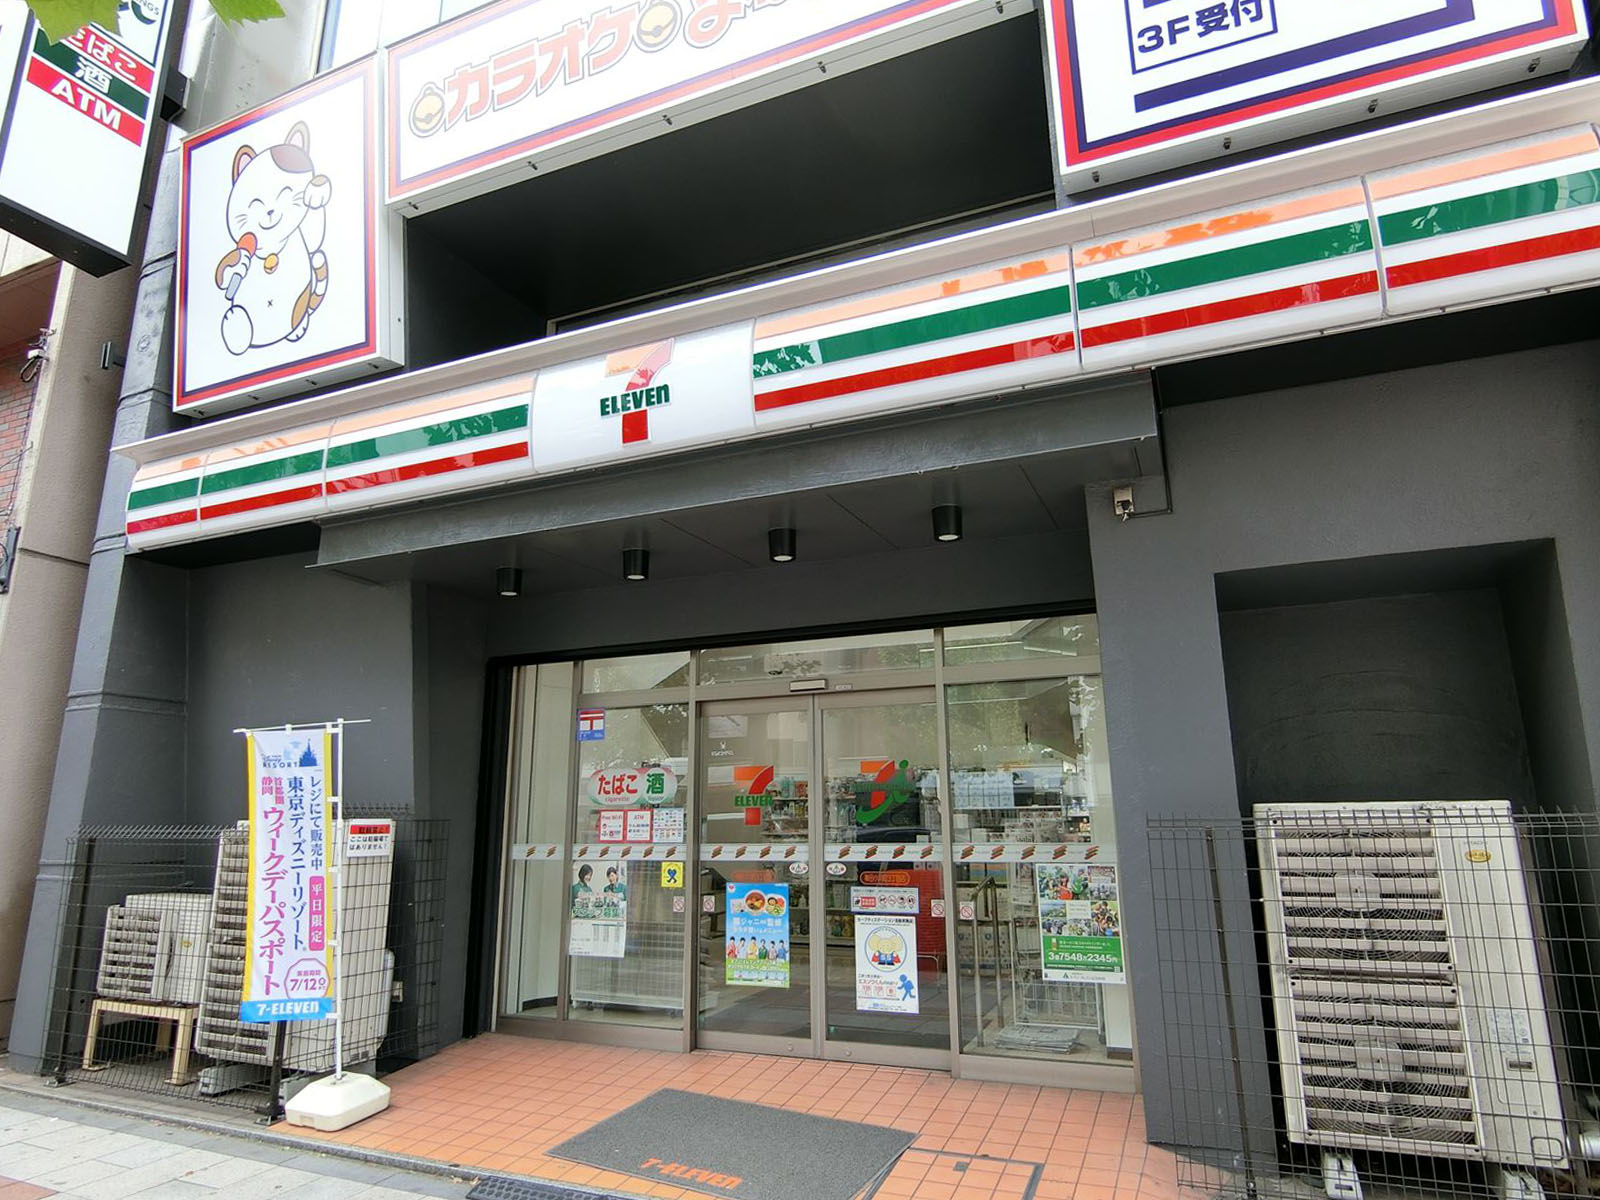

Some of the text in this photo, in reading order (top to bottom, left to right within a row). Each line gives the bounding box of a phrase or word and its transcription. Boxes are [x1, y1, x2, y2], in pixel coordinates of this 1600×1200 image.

[73, 56, 113, 94] 酒
[446, 6, 637, 124] カラオケ
[51, 78, 122, 131] ATM
[597, 774, 638, 795] たばこ
[646, 772, 665, 794] 酒
[310, 775, 323, 871] レジにて販売中
[286, 776, 307, 950] 東京ディズニーリゾート
[258, 806, 288, 996] ウィークデーパスポート
[311, 883, 323, 943] 平日限定
